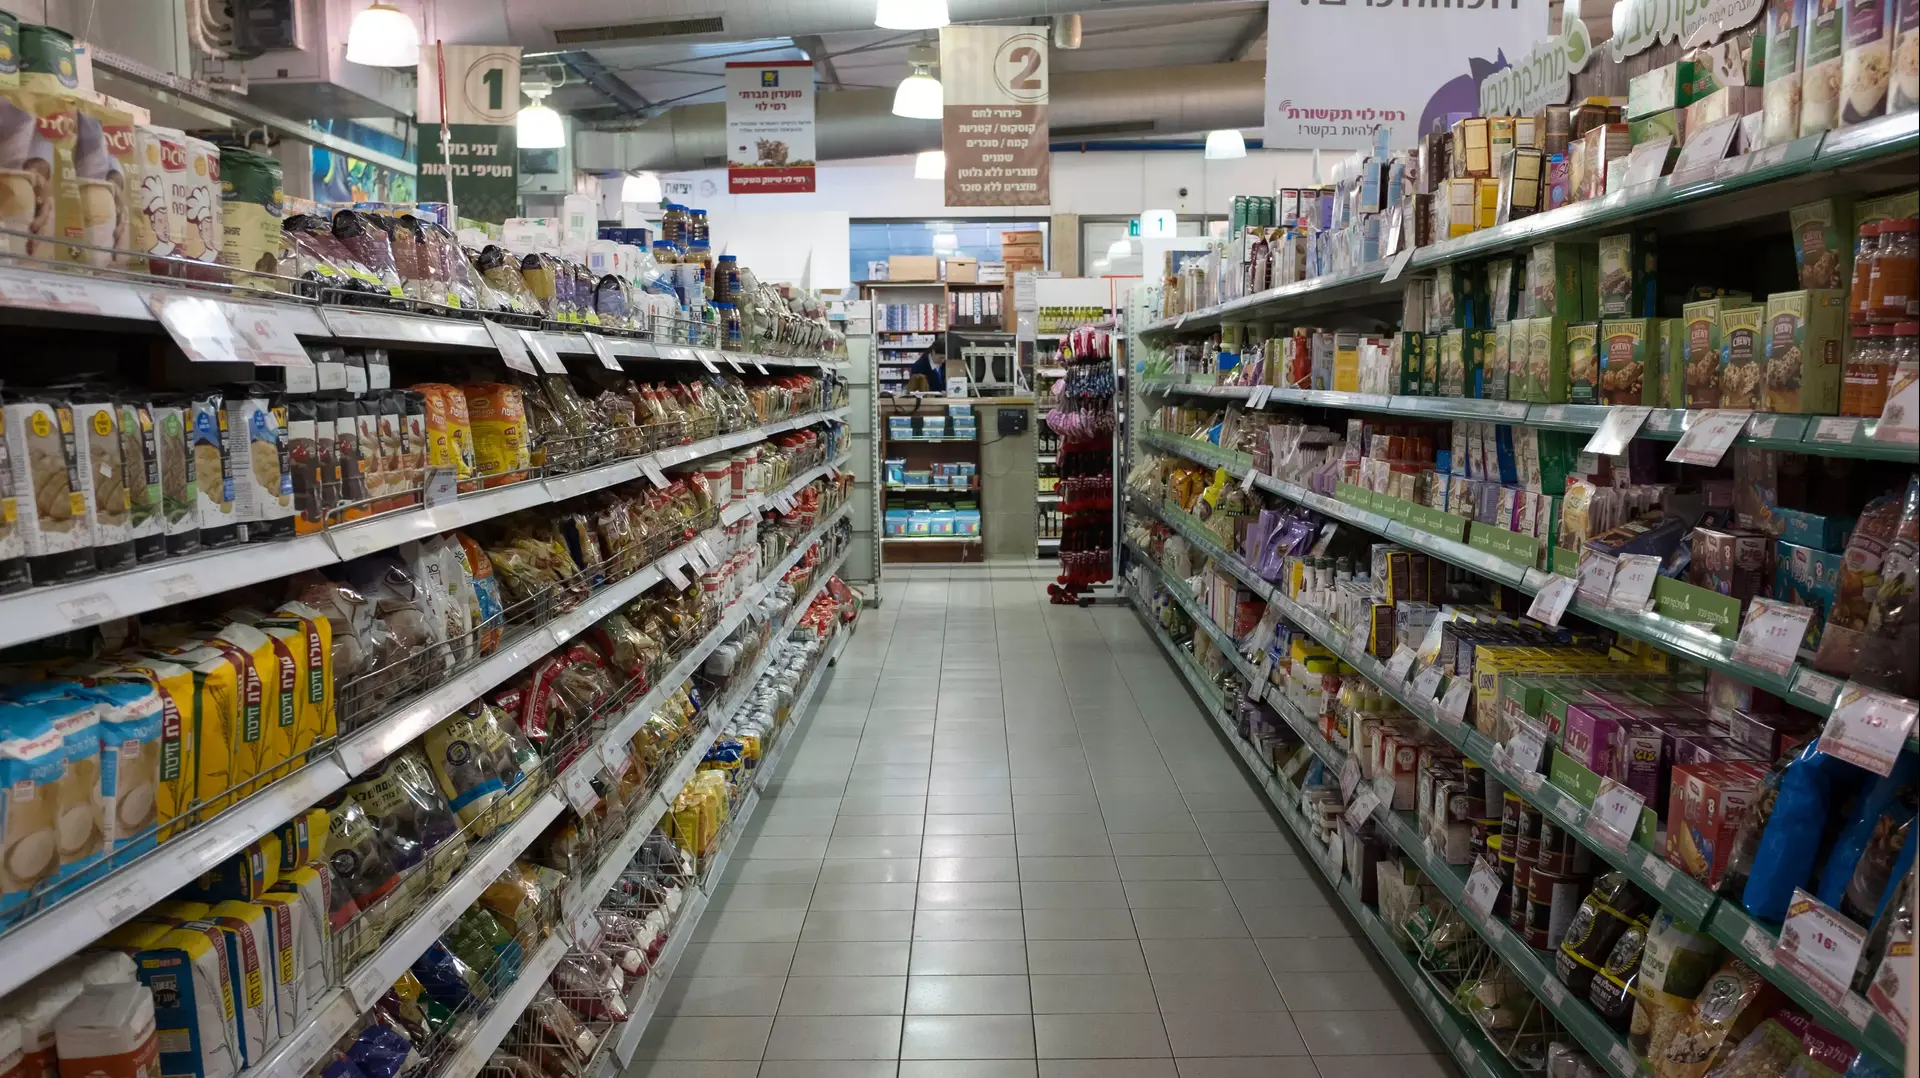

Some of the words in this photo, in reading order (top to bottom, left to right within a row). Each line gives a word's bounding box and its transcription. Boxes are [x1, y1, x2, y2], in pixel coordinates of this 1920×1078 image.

[1010, 46, 1042, 89] 2
[483, 69, 503, 110] 1
[739, 91, 770, 99] חברתי
[772, 90, 802, 100] מועדון
[755, 102, 768, 110] לוי
[972, 108, 992, 118] לחם
[1287, 108, 1352, 122] תקשורת
[1356, 108, 1375, 120] לוי
[1380, 110, 1405, 121] רמי
[959, 124, 992, 134] קטניות
[1000, 124, 1036, 134] קוסקוס
[966, 139, 998, 148] סוכרים
[1007, 139, 1028, 149] קמח
[472, 144, 497, 156] דגני
[982, 154, 1014, 162] שמנים
[472, 165, 512, 177] חטיפי
[984, 168, 1002, 176] ללא
[960, 183, 982, 192] סוכר
[984, 182, 1002, 191] ללא
[1004, 182, 1036, 191] מוצרים
[1158, 216, 1162, 231] 1
[1604, 323, 1622, 335] NATURE
[1774, 323, 1792, 334] CHEWY
[1610, 343, 1631, 352] CHEWY
[1732, 336, 1752, 348] CHEWY
[1816, 561, 1822, 577] 8
[310, 632, 322, 667] סולת
[281, 656, 295, 689] סולת
[247, 666, 261, 702] סולת
[310, 670, 322, 701] חיטה
[1478, 670, 1494, 691] CORNY
[282, 693, 294, 726] חיטה
[162, 696, 180, 738] סולת
[246, 706, 260, 741] חיטה
[164, 741, 179, 780] חיטה
[1707, 798, 1715, 814] 8
